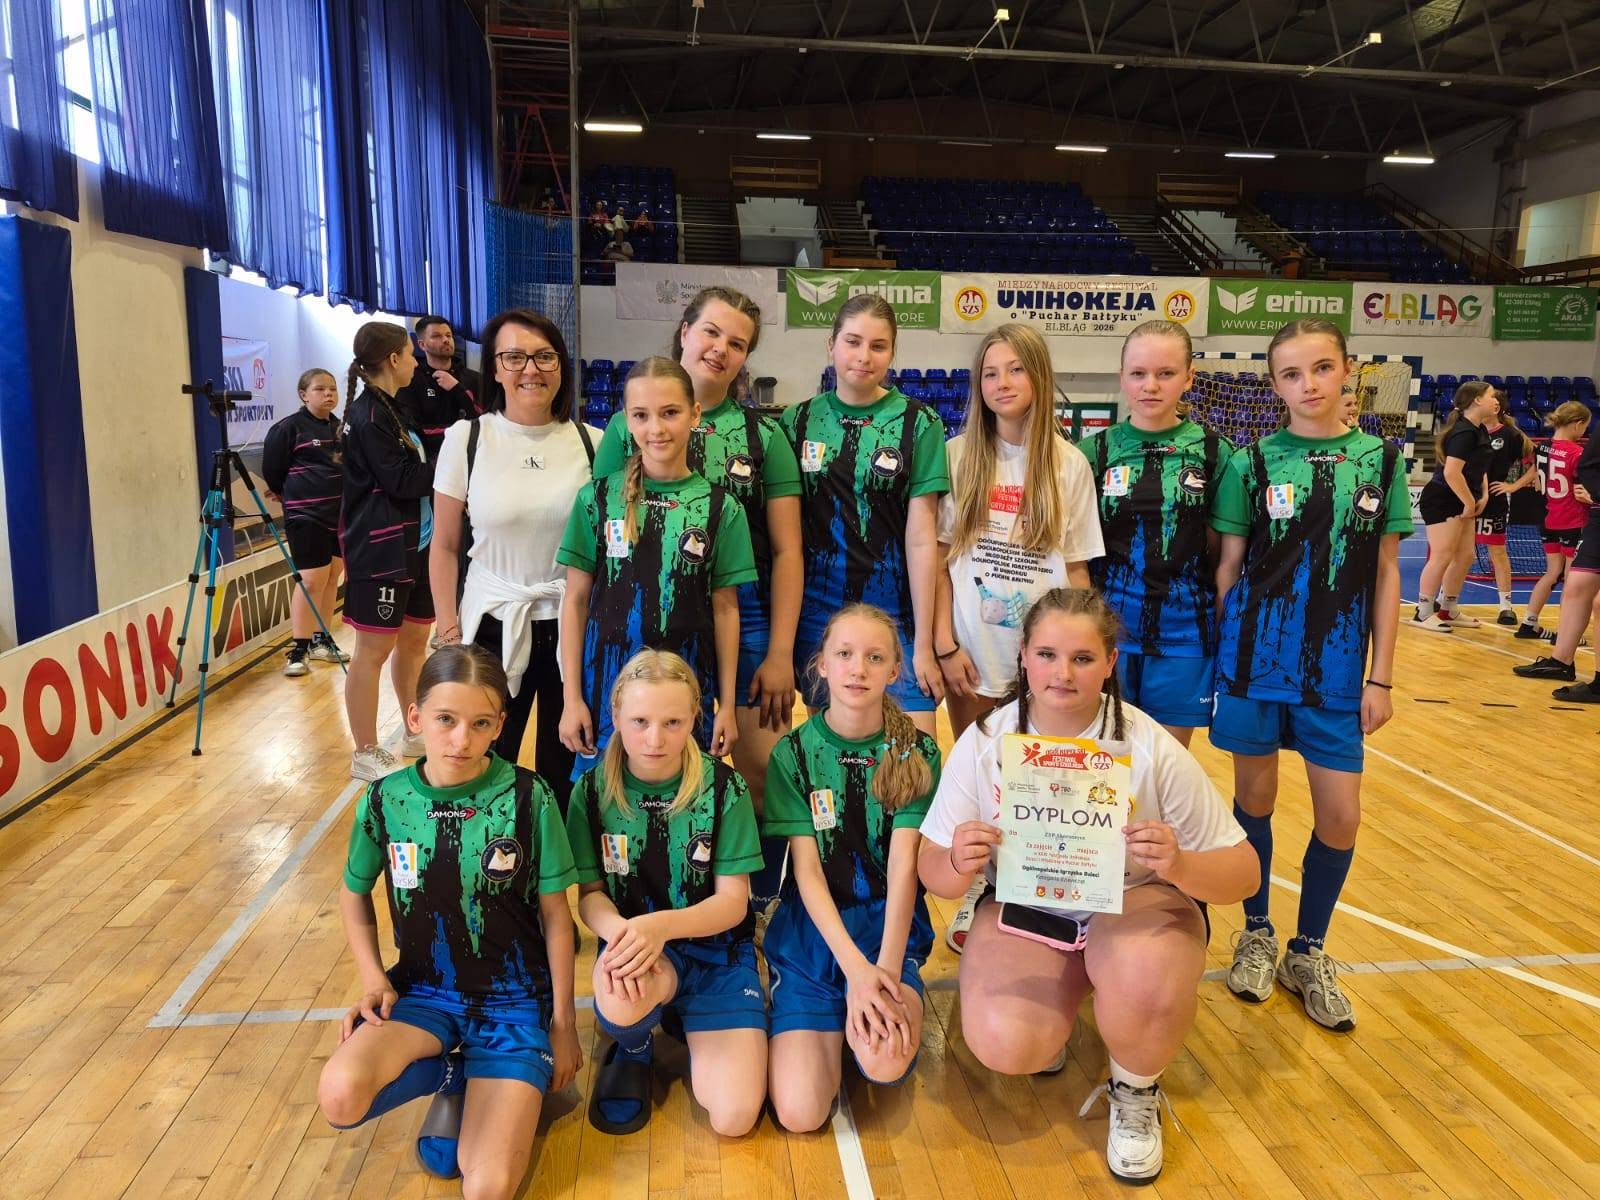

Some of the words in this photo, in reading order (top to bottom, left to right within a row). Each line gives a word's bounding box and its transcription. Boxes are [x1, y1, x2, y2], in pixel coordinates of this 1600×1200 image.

[997, 290, 1156, 311] UNIHOKEJA
[1265, 290, 1344, 315] erima
[1022, 311, 1077, 321] "Puchar
[1083, 312, 1142, 323] Bałtyku"
[1221, 319, 1289, 331] WWW.ERIM
[1045, 323, 1087, 333] ELBLĄG
[1093, 324, 1115, 332] 2026
[1536, 454, 1570, 499] 55
[1476, 517, 1494, 536] 15
[378, 586, 395, 604] 11
[427, 809, 467, 819] DAMONS
[1013, 804, 1113, 829] DYPLOM
[1058, 842, 1067, 851] 6
